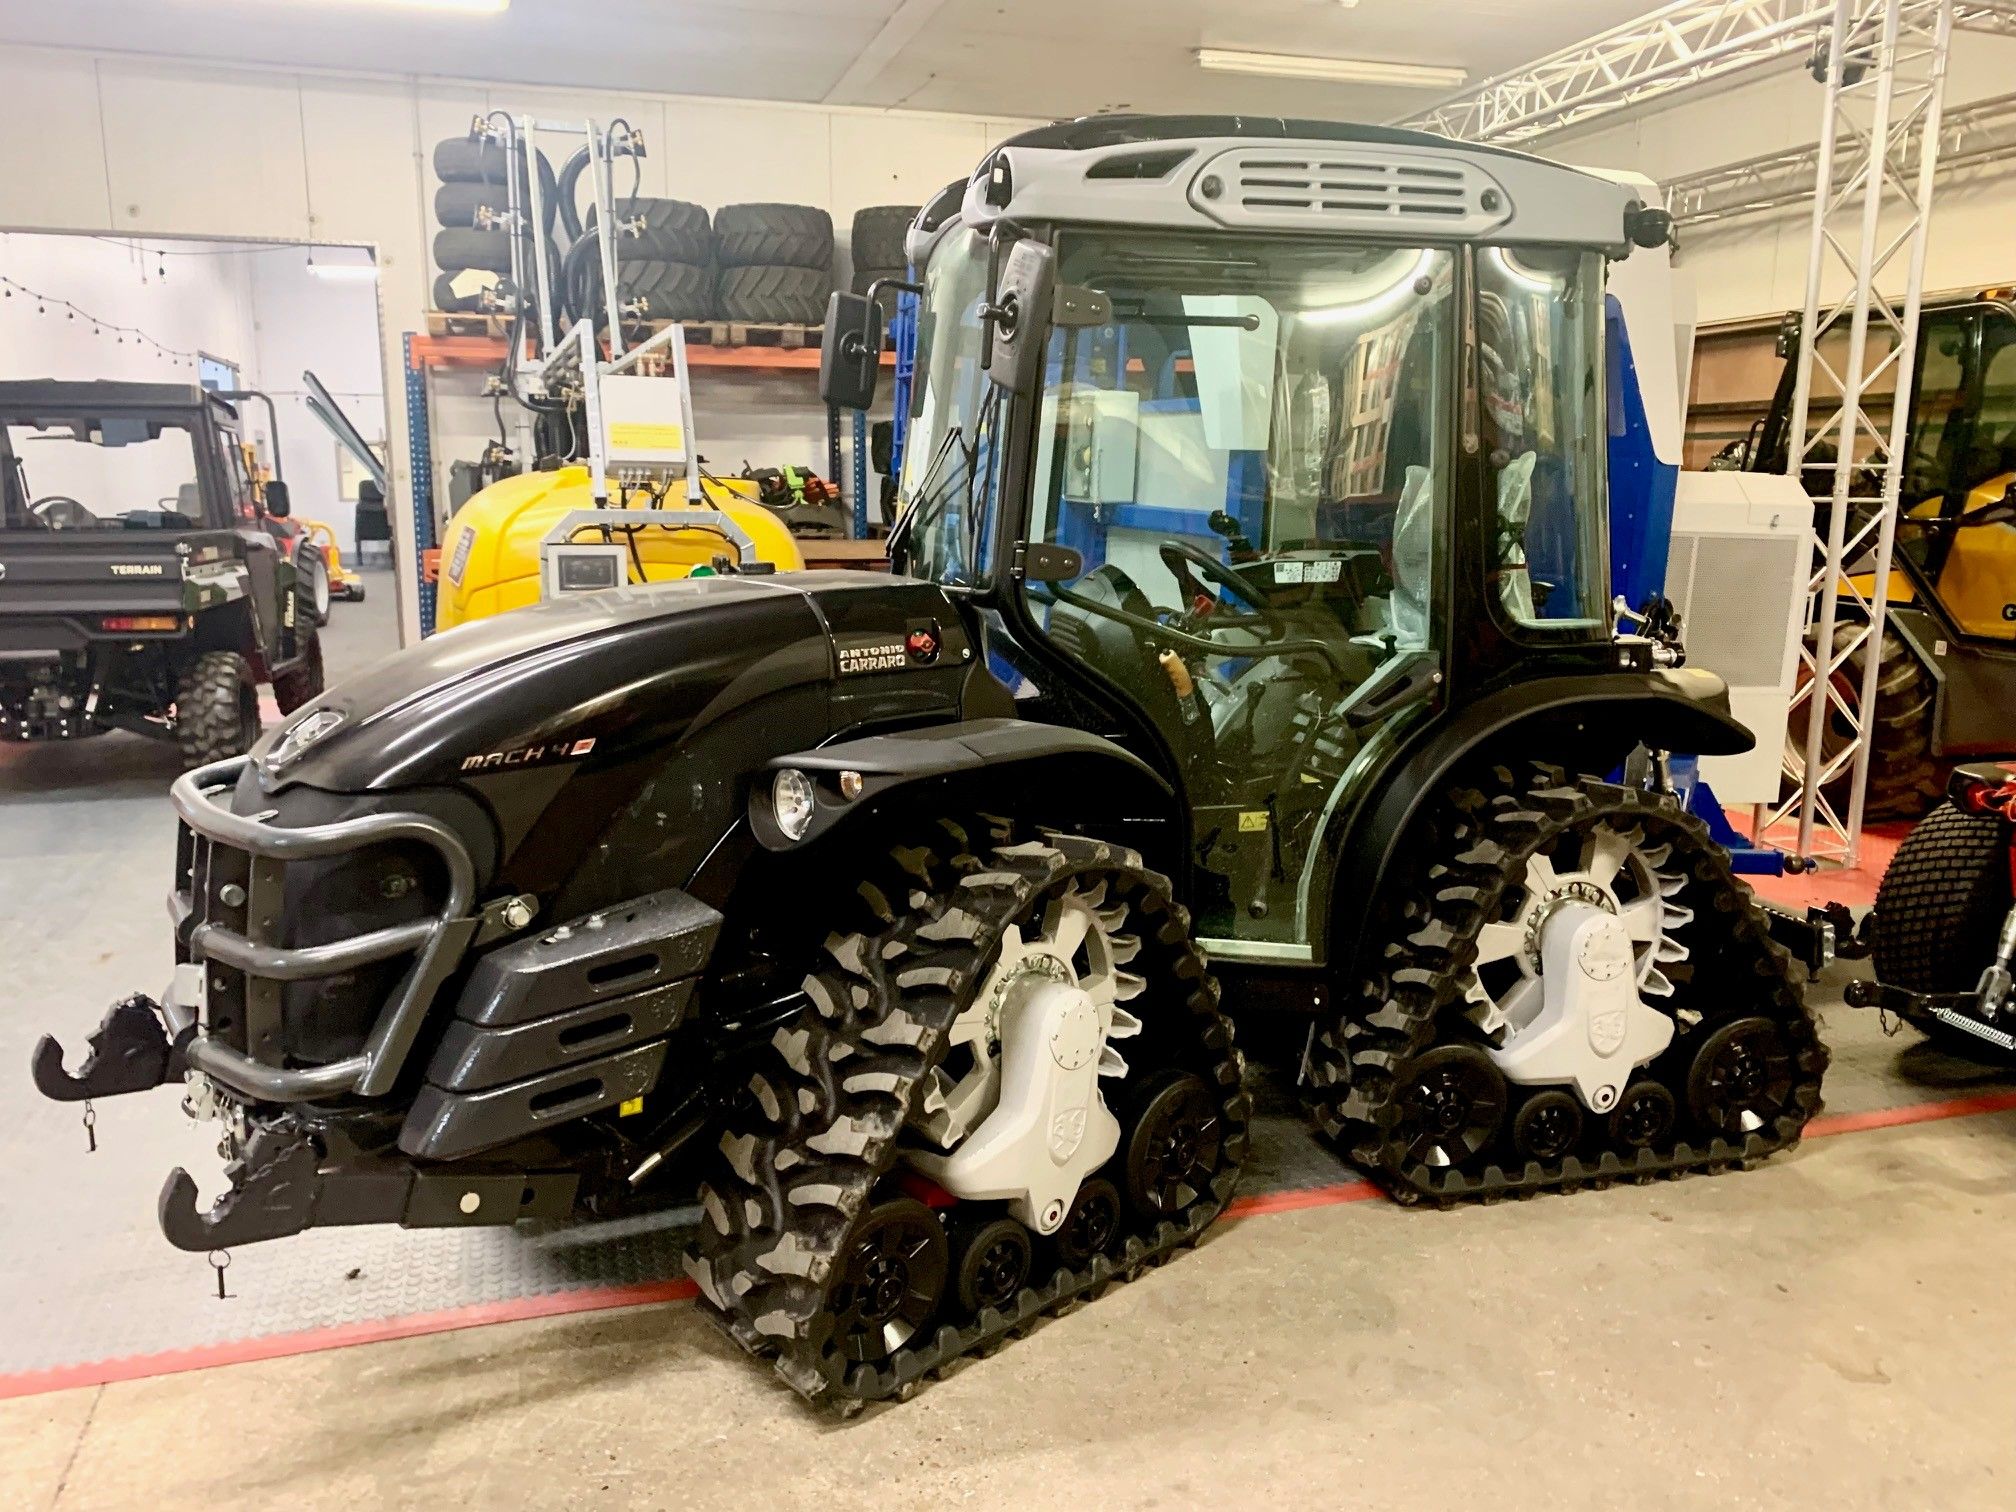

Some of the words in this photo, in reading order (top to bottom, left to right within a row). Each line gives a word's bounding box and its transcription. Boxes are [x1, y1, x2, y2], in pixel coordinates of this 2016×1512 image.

[110, 565, 162, 575] TERRAIN
[840, 645, 905, 658] ANTONIO
[840, 655, 905, 672] CARRARO
[460, 746, 545, 770] MACH
